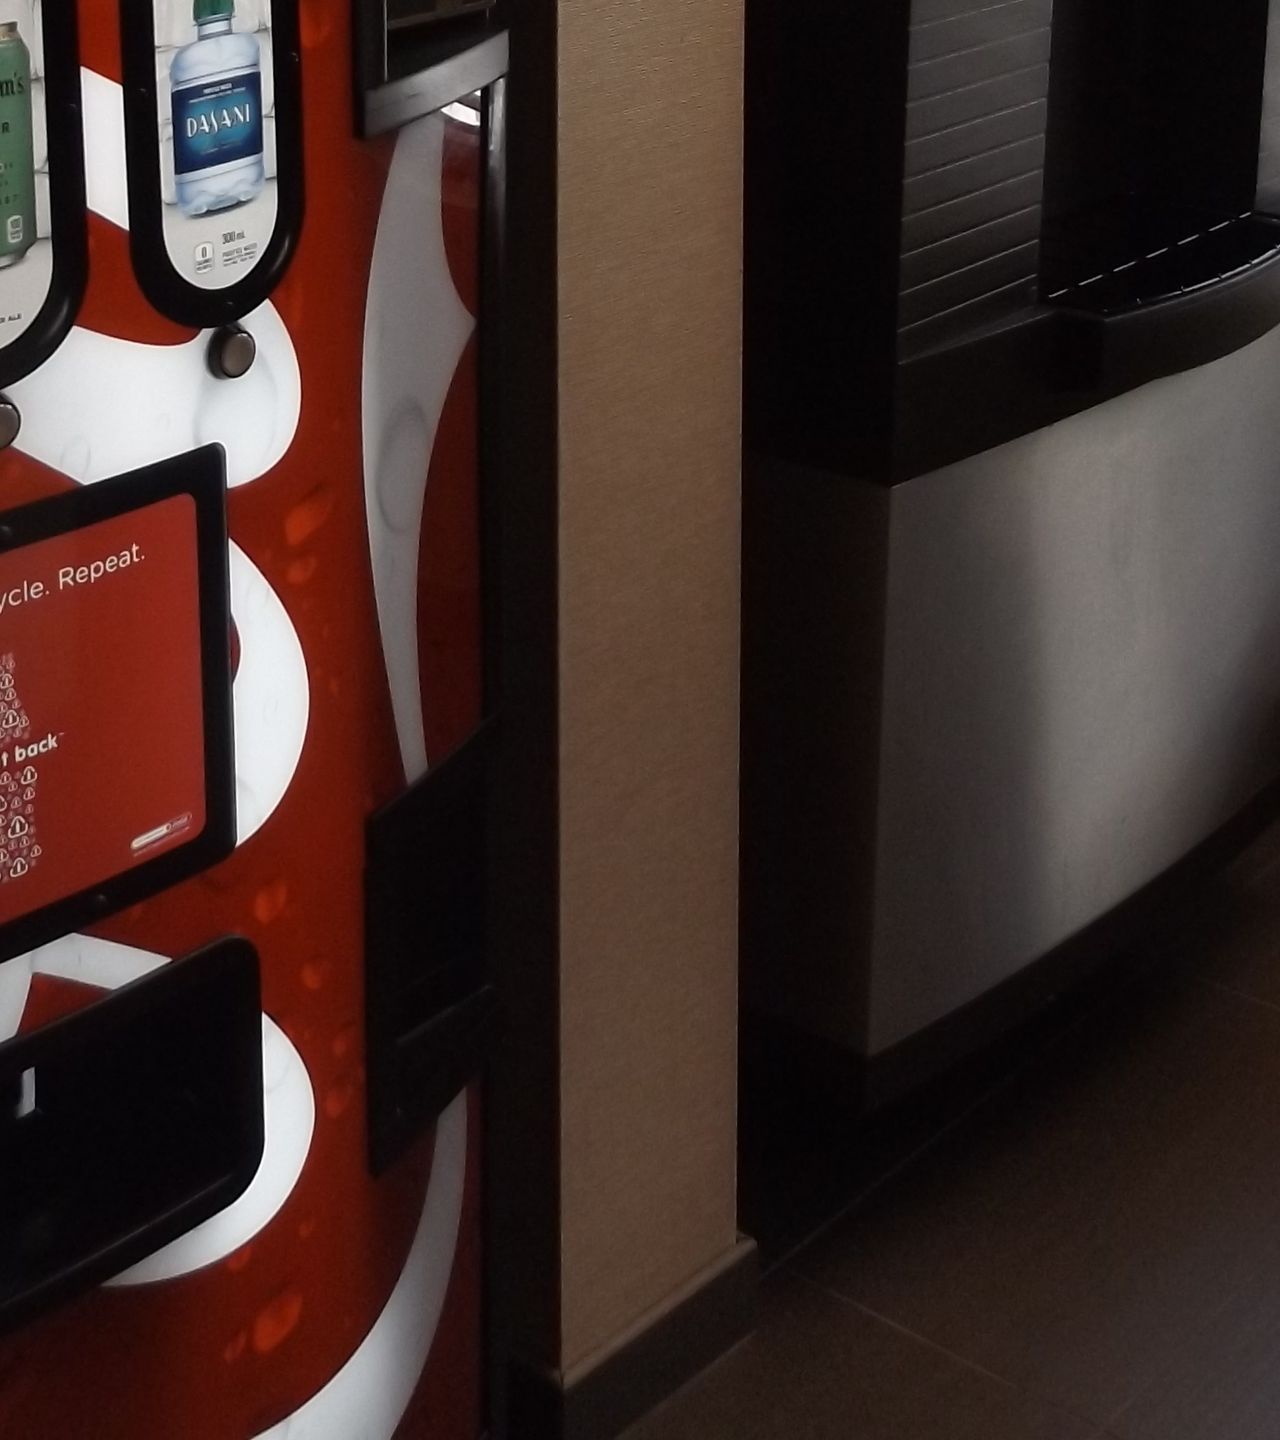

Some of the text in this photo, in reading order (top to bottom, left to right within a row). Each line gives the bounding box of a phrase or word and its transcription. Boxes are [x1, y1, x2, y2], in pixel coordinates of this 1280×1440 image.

[186, 103, 251, 138] DASANI
[58, 542, 145, 590] Repeat.
[14, 732, 58, 763] back
